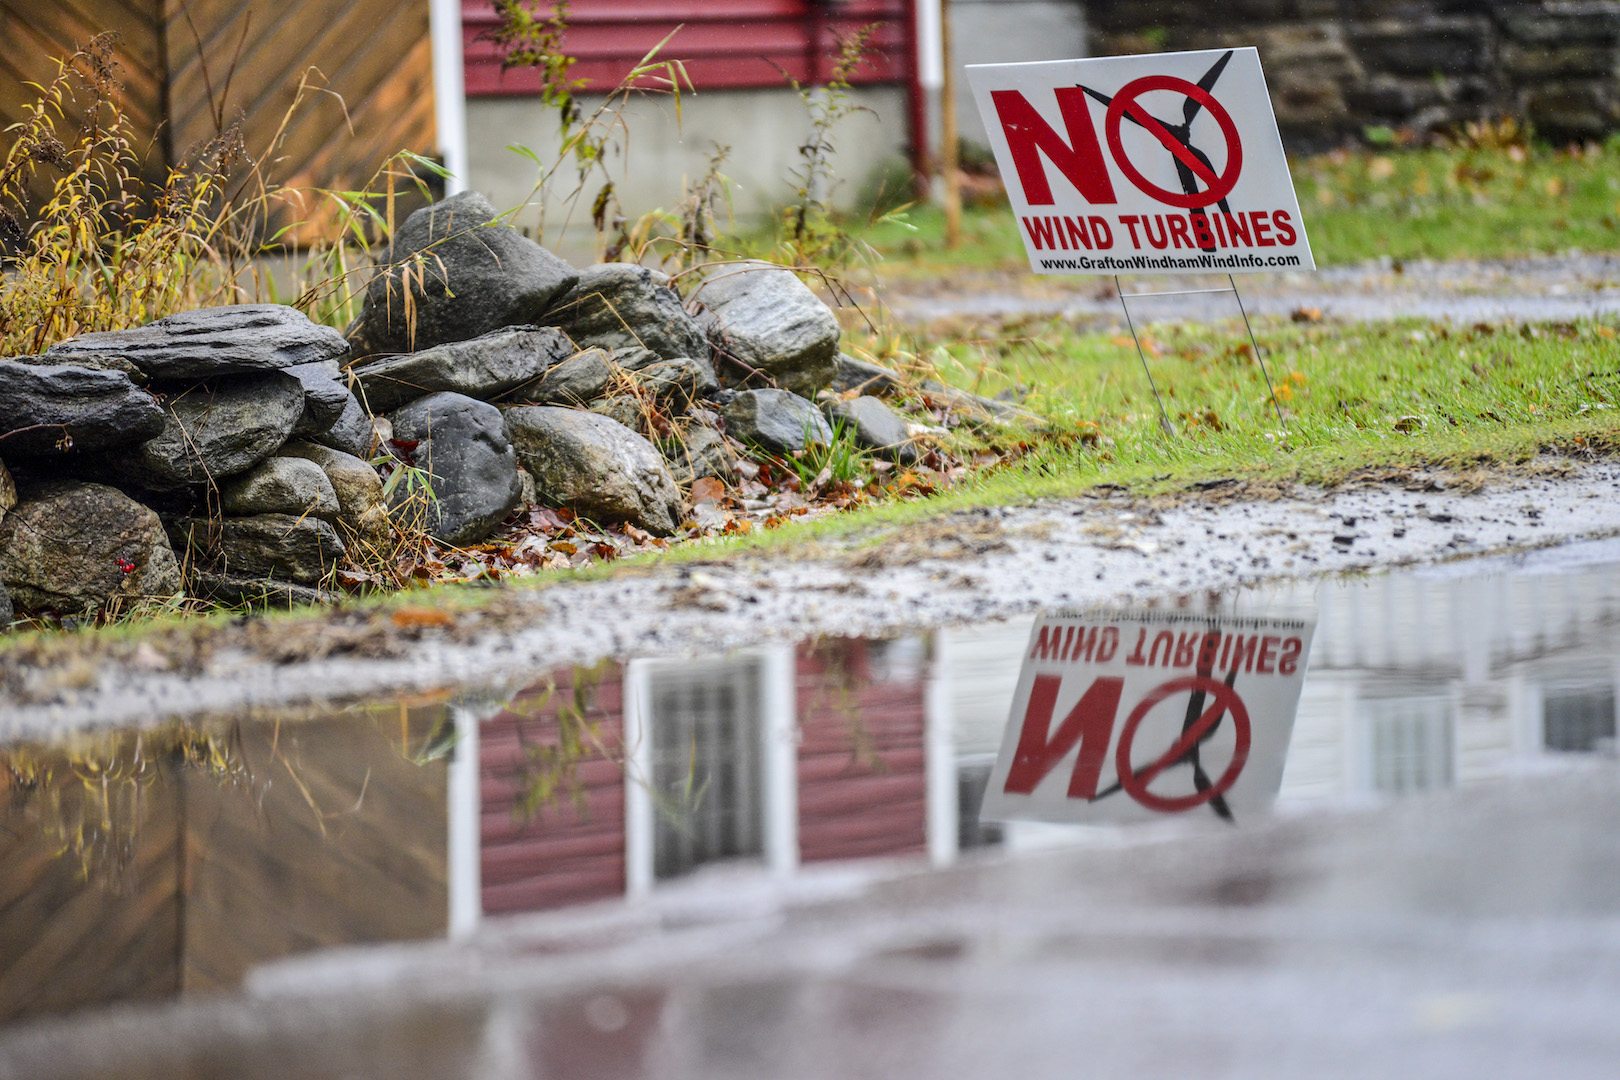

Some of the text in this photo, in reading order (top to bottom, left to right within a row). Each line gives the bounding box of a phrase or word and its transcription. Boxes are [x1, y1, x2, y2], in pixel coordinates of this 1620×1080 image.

[990, 75, 1243, 209] NO
[1022, 209, 1298, 252] WIND TURBINES
[1040, 253, 1301, 271] www.GraftonWindhamWindInfo.com
